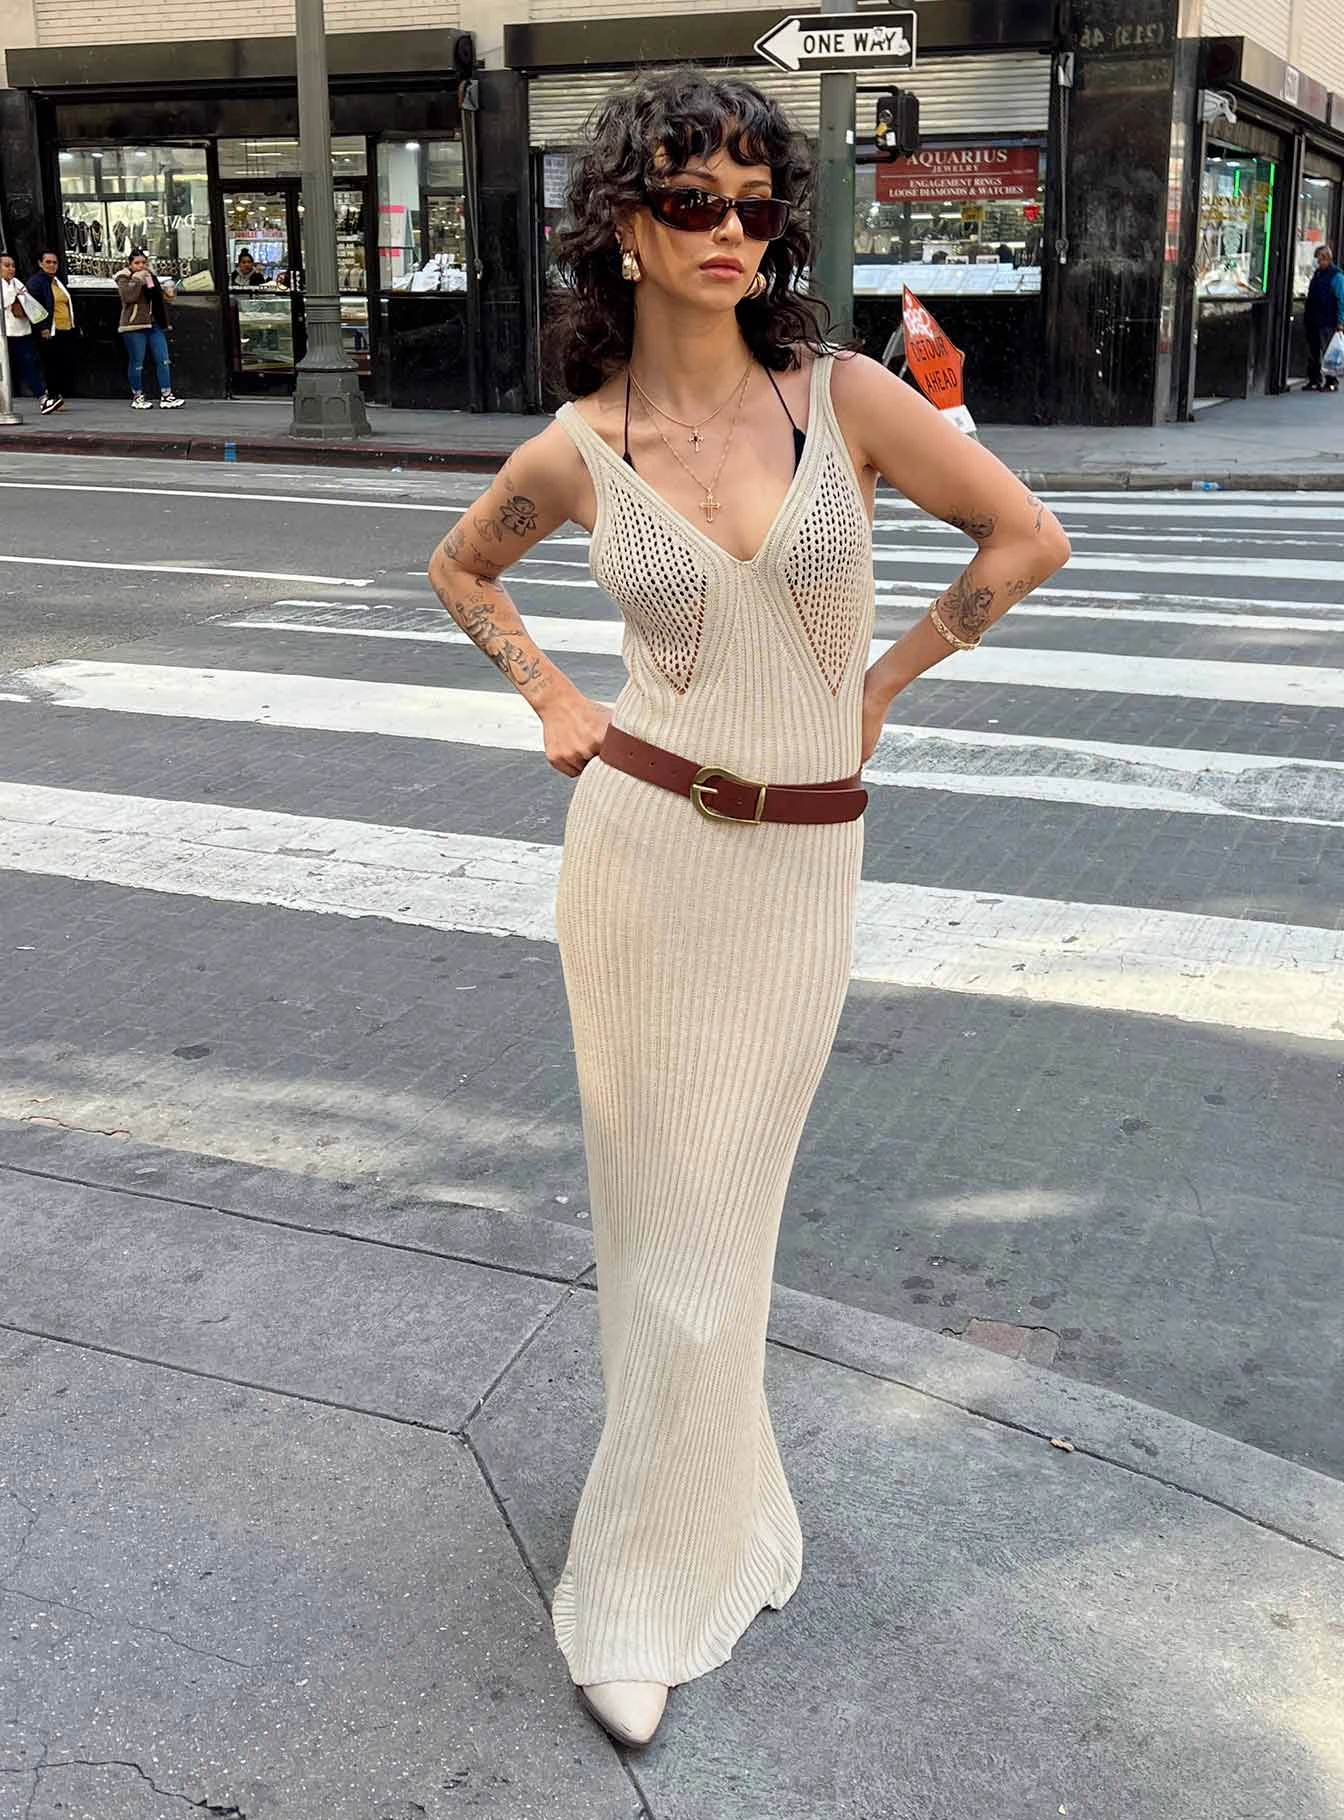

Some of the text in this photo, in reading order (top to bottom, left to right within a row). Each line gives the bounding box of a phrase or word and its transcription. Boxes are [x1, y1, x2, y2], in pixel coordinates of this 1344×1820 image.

[803, 31, 897, 54] ONE WAY
[906, 149, 1008, 168] AQUARIUS
[932, 164, 979, 174] JEWELRY
[889, 185, 1025, 198] LOOSE DIAMONDS & WATCHES
[909, 177, 1002, 188] ENGAGEMENT RINGS
[910, 336, 949, 362] DETOUR
[924, 367, 958, 393] AHEAD
